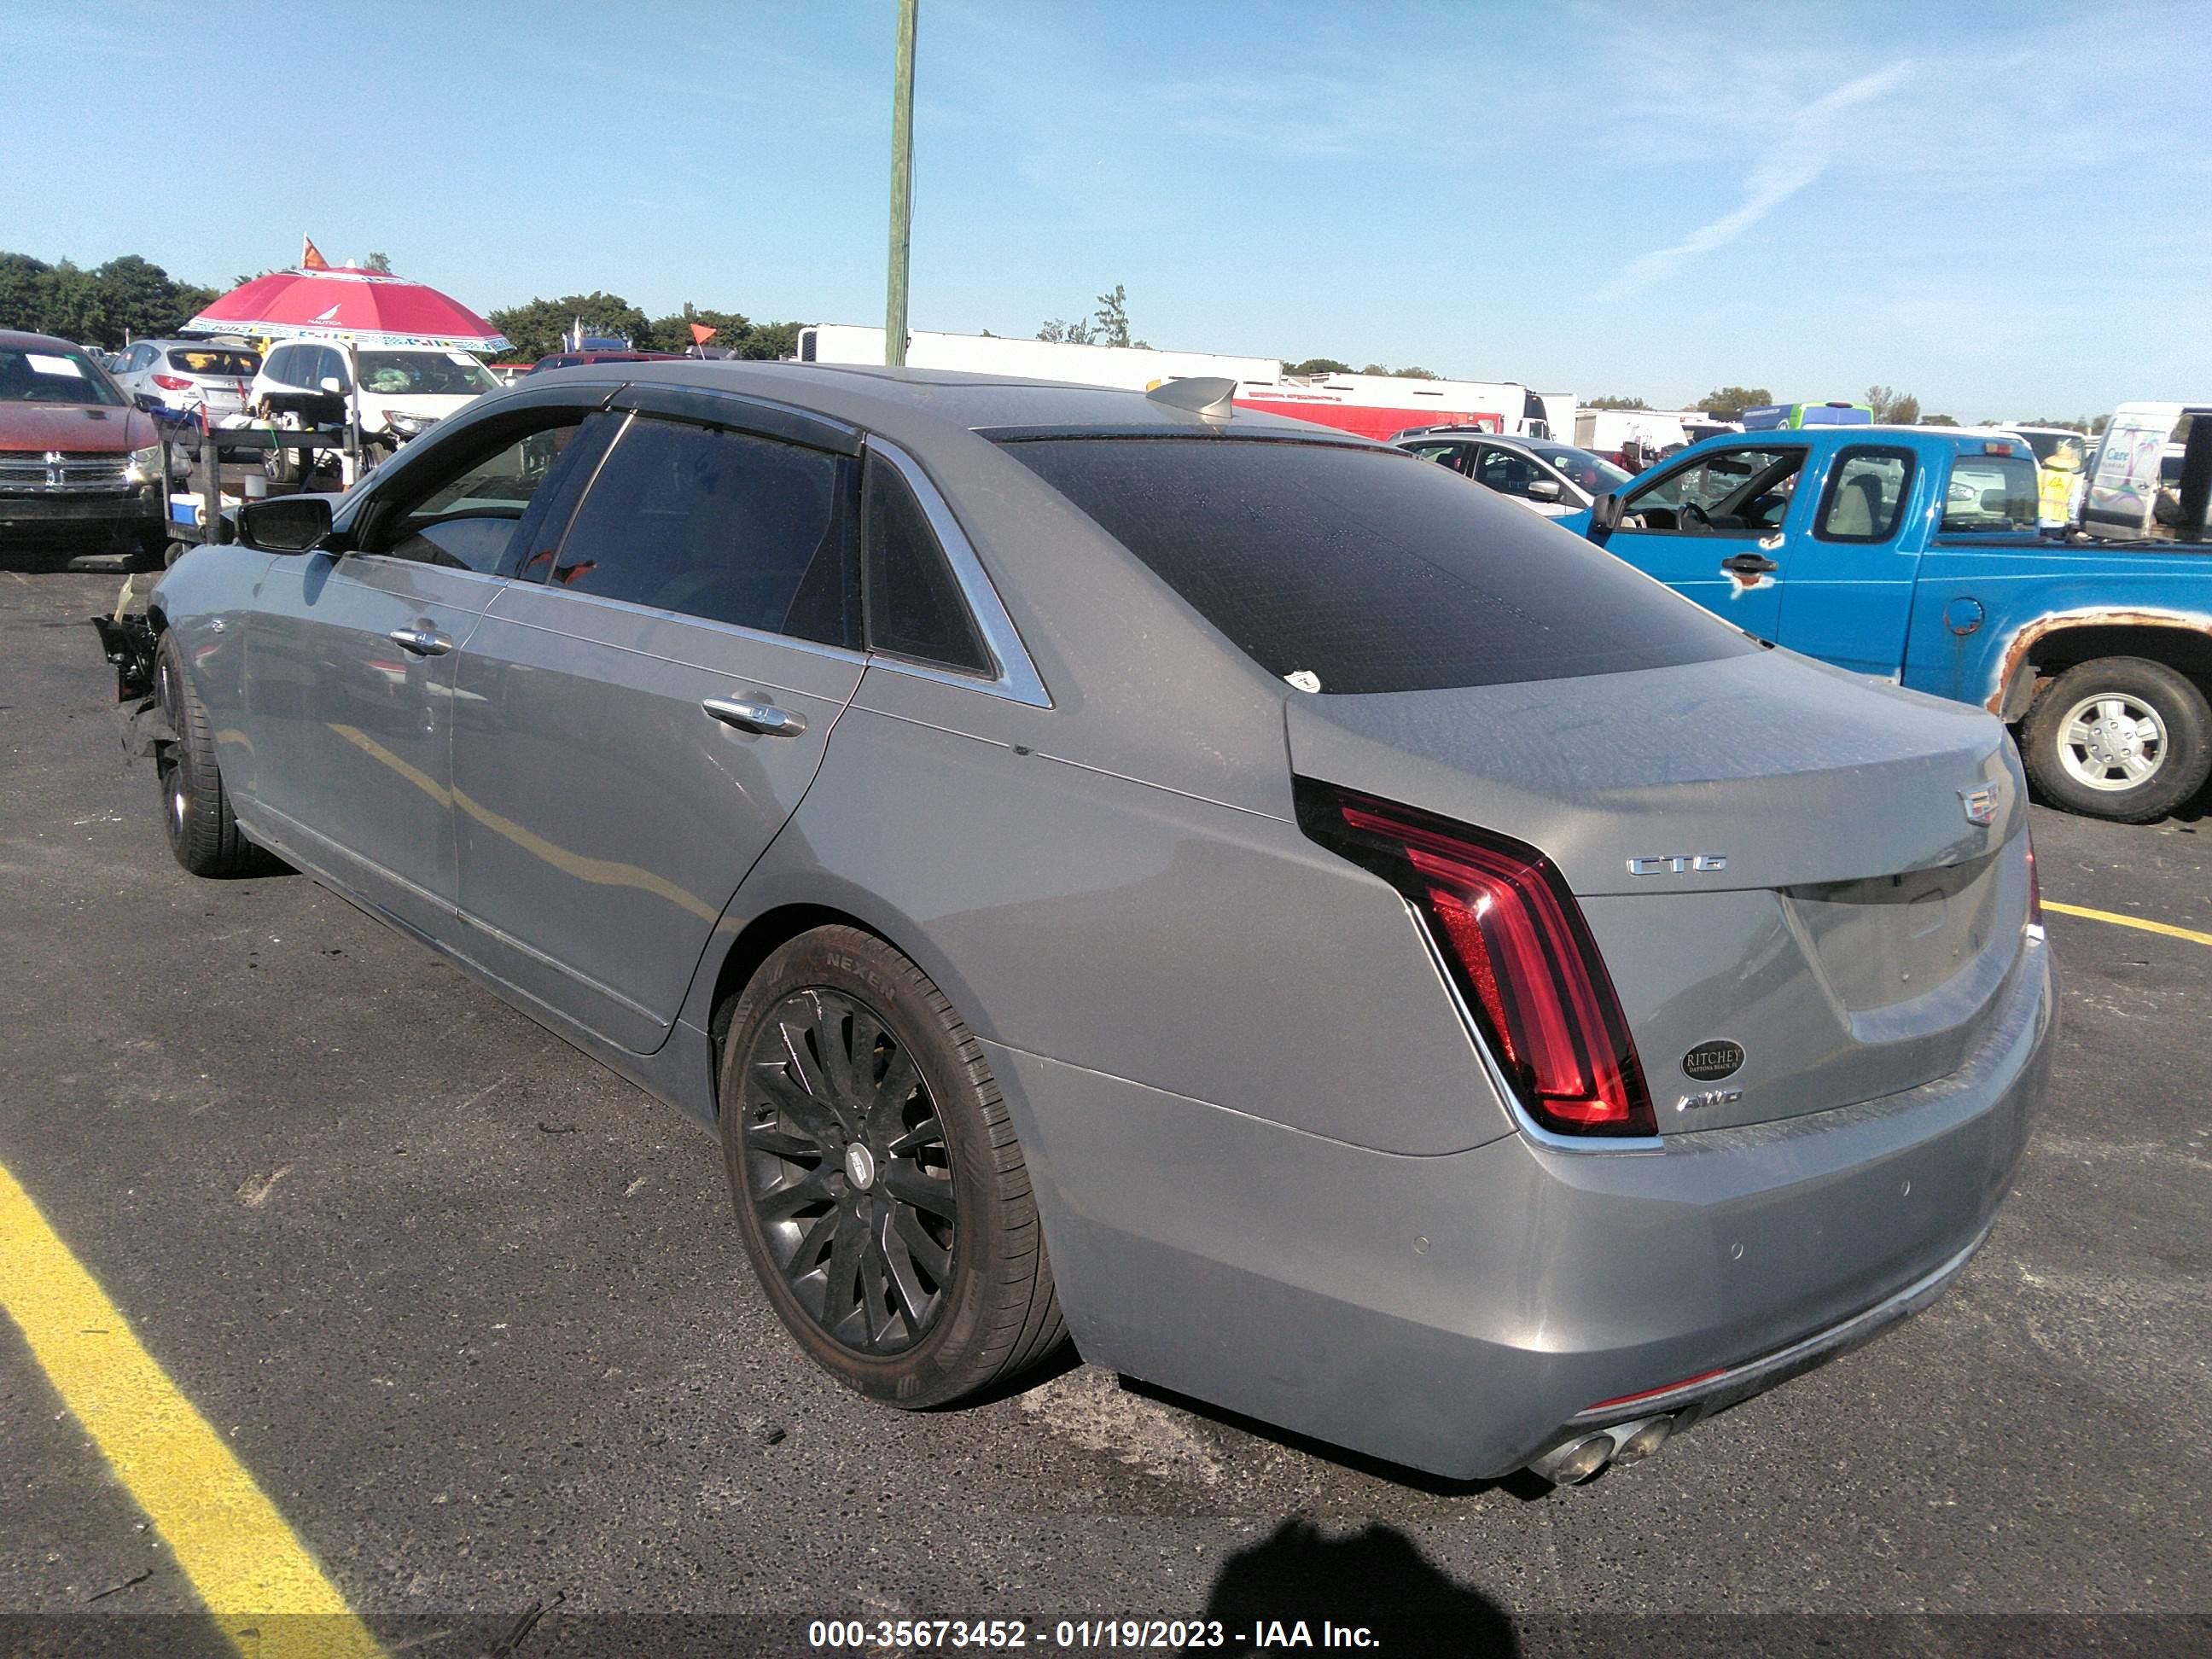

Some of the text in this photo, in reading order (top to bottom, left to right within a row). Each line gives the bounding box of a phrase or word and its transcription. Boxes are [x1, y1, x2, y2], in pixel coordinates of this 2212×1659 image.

[2106, 447, 2131, 462] Care
[1627, 853, 1727, 876] CT6
[825, 952, 897, 1004] NEXEN
[1687, 1049, 1741, 1068] RITCHEY
[1676, 1086, 1743, 1112] AWD
